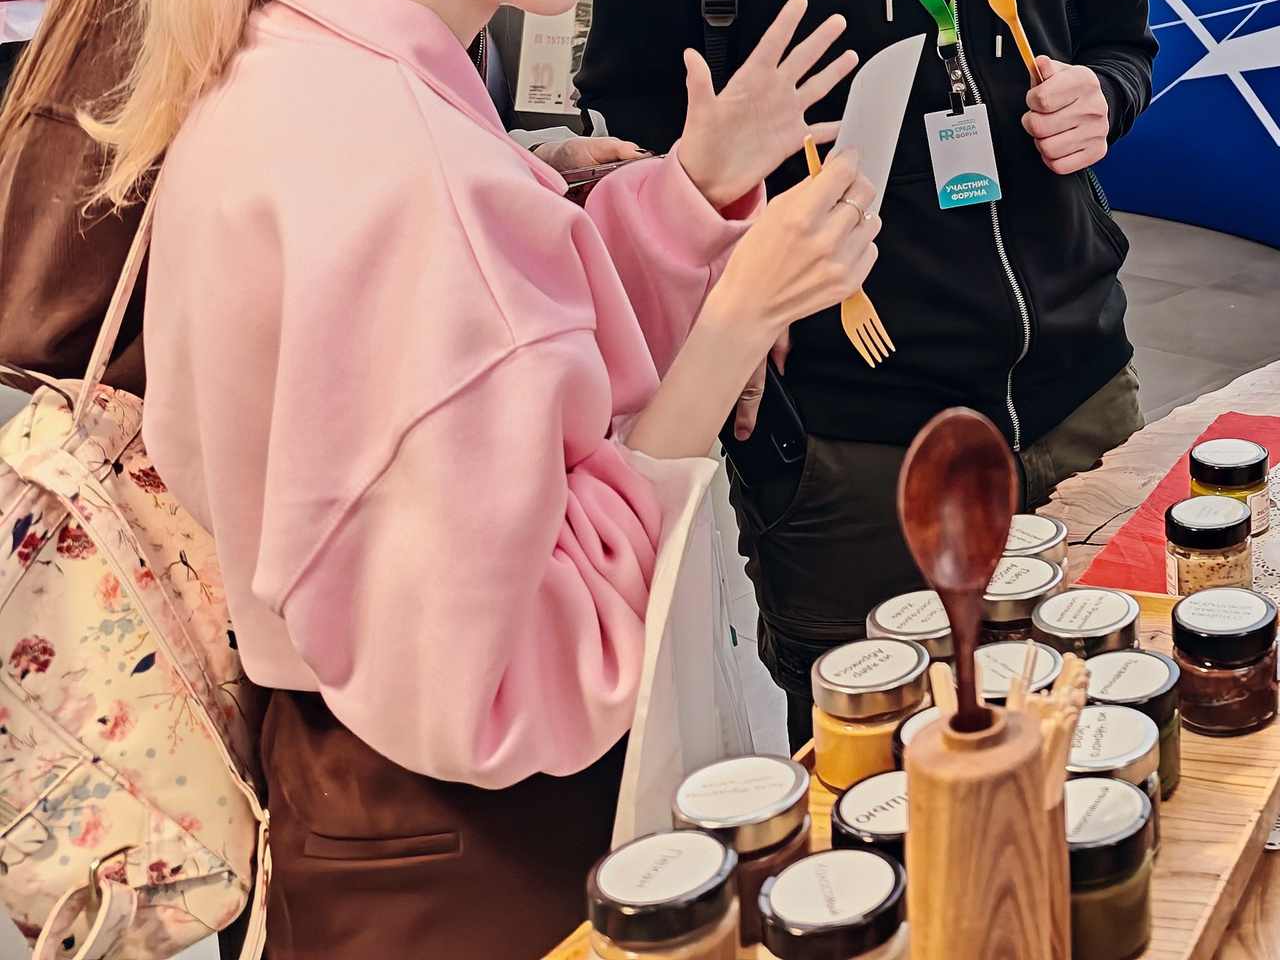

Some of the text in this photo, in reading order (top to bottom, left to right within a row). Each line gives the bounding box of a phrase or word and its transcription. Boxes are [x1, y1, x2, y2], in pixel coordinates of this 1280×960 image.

[954, 124, 976, 133] СРЕДА
[955, 130, 978, 139] ФОРУМ
[945, 178, 990, 193] УЧАСТНИК
[951, 188, 987, 201] ФОРУМА
[633, 848, 684, 888] Пекан
